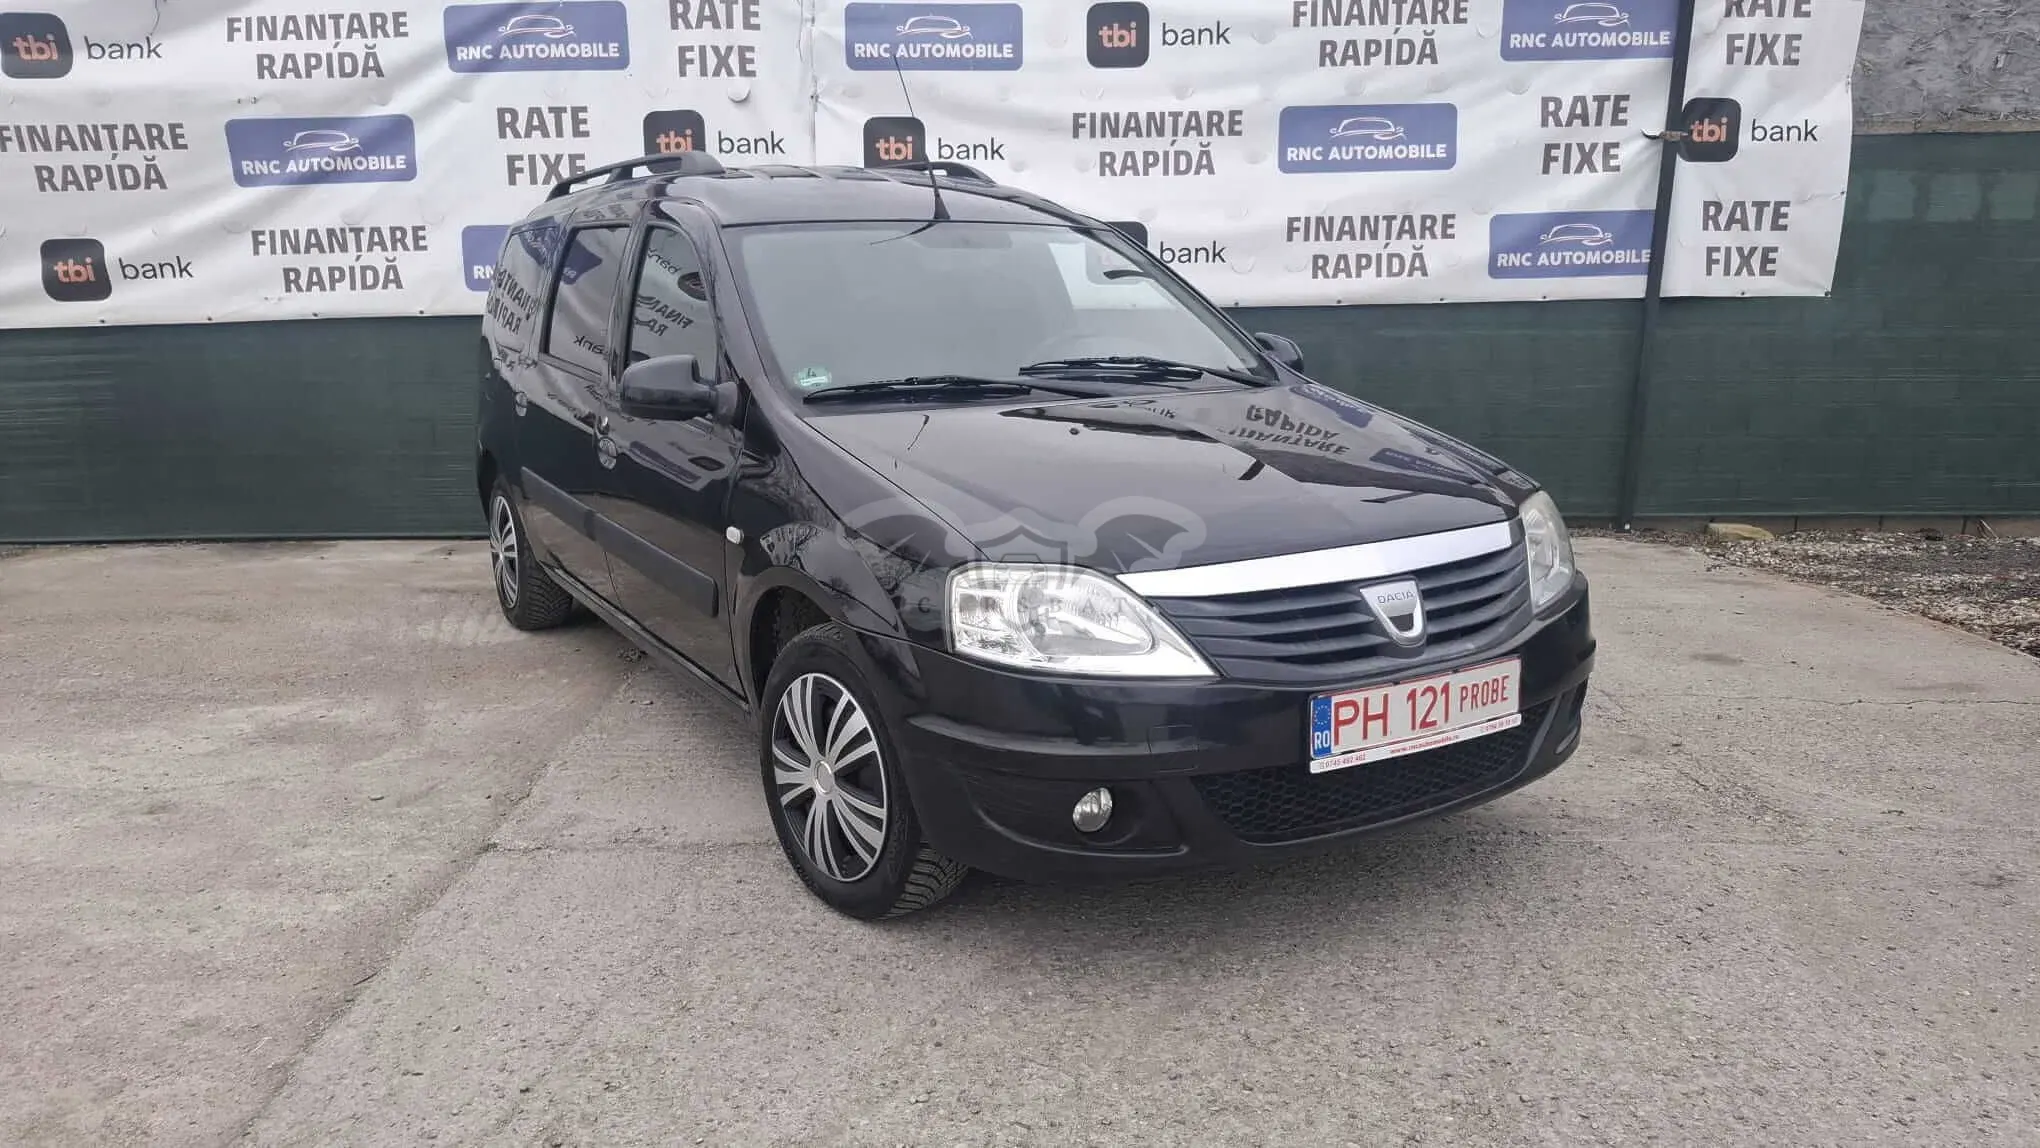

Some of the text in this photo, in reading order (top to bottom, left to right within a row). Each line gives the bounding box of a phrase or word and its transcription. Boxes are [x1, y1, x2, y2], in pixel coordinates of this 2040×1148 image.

[669, 0, 761, 30] RATE
[12, 34, 163, 61] tbi bank
[1099, 20, 1231, 48] tbi bank
[1510, 31, 1671, 48] RNC AUTOMOBILE
[456, 43, 620, 61] RNC AUTOMOBILE
[678, 45, 757, 77] FIXE
[854, 43, 1014, 58] RNC AUTOMOBILE
[1726, 33, 1802, 66] FIXE
[497, 106, 590, 139] RATE
[1541, 94, 1630, 128] RATE
[656, 129, 785, 155] tbi bank
[1691, 117, 1818, 142] tbi bank
[876, 136, 1005, 161] tbi bank
[1287, 144, 1447, 161] RNC AUTOMOBILE
[1541, 142, 1621, 175] FIXE
[241, 155, 407, 175] RNC AUTOMOBILE
[506, 153, 587, 186] FIXE
[1702, 200, 1790, 231] RATE
[1159, 240, 1226, 264] bank
[1497, 249, 1651, 267] RNC AUTOMOBILE
[1705, 246, 1779, 277] FIXE
[53, 256, 193, 283] tbi bank
[1377, 590, 1414, 604] DACIA
[1333, 675, 1510, 747] PH 121 PROBE
[1314, 731, 1331, 751] RO
